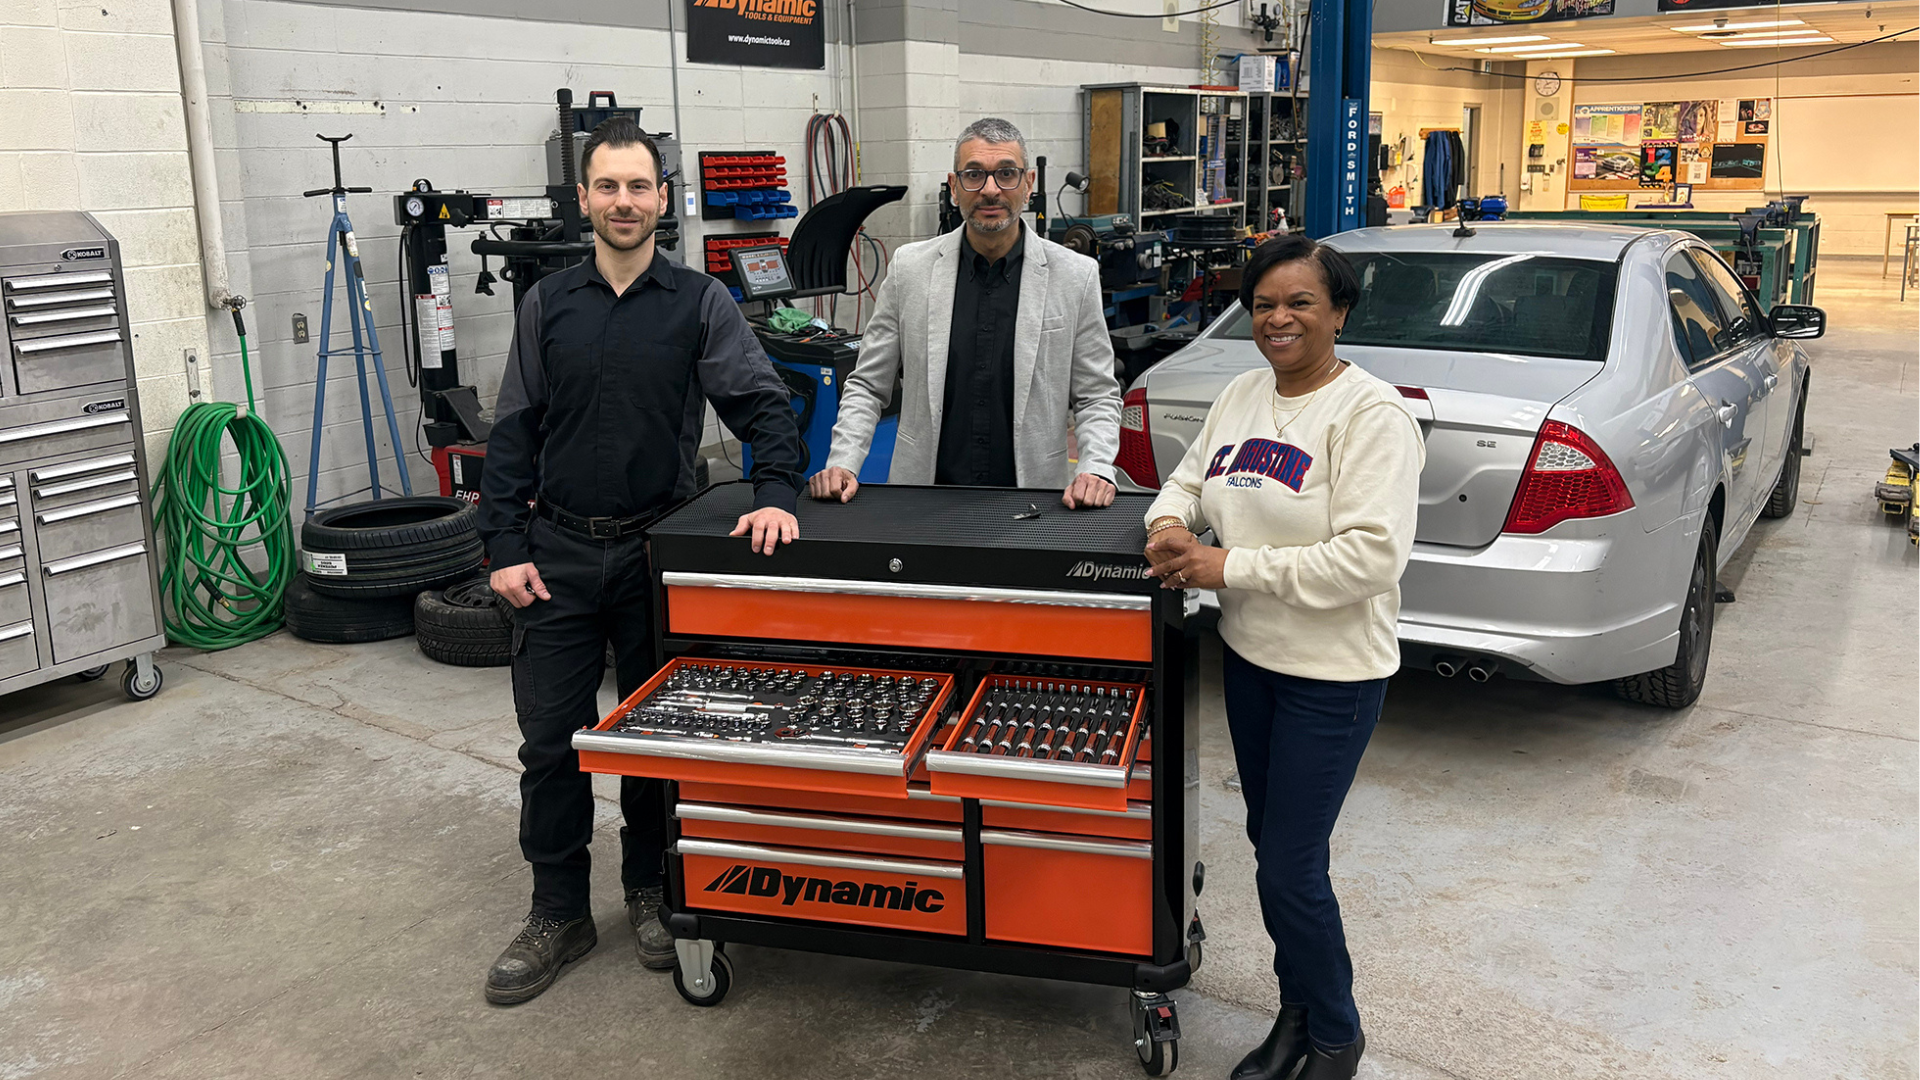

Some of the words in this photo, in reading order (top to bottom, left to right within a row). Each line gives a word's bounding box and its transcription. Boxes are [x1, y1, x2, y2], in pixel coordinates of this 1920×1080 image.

[745, 11, 767, 21] TOOLS
[767, 13, 773, 21] &
[774, 15, 813, 25] EQUIPMENT
[1454, 0, 1471, 23] CAT
[728, 34, 791, 47] www.dynamictools.ca
[1590, 105, 1641, 113] APPRENTICESHIP
[1347, 107, 1358, 152] FORD
[1645, 148, 1656, 163] 1
[1656, 148, 1672, 165] 2
[1655, 166, 1673, 181] 4
[1345, 160, 1356, 216] SMITH
[77, 250, 102, 258] KOBALT
[1477, 440, 1497, 448] SE
[1226, 477, 1263, 489] FALCONS
[748, 867, 945, 913] Dynamic
